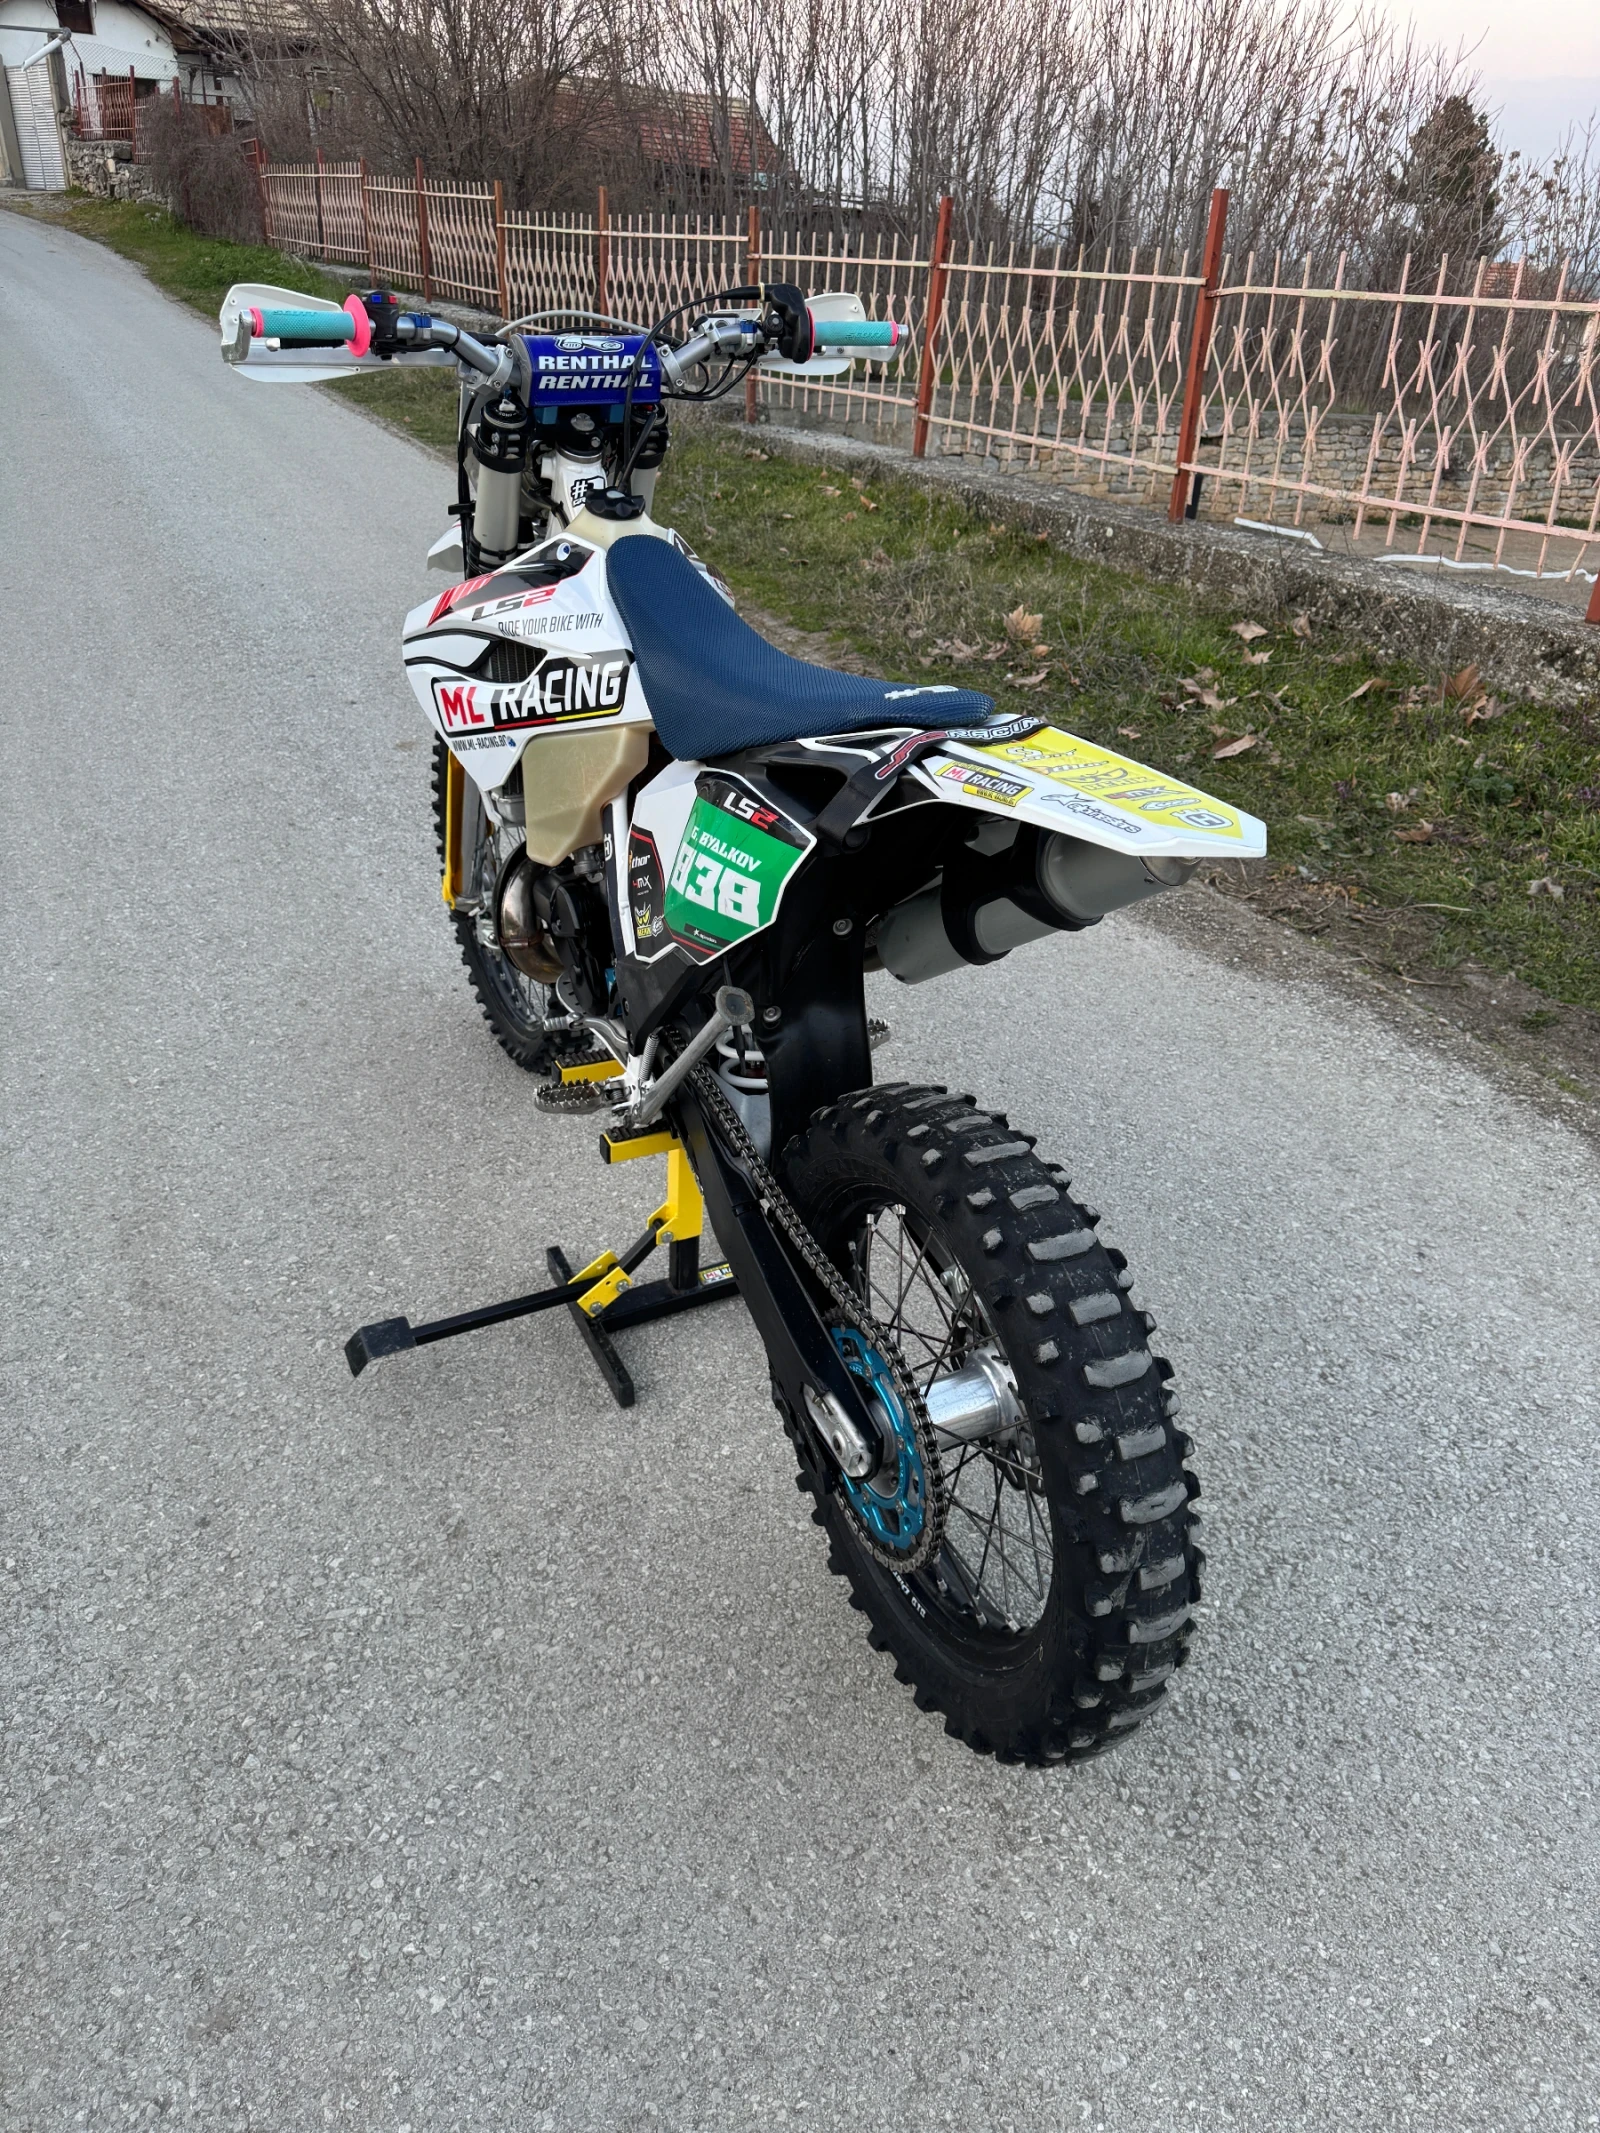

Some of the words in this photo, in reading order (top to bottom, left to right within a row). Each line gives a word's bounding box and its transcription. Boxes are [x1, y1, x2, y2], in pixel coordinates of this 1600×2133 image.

[538, 355, 653, 370] RENTHAL
[538, 373, 653, 390] RENTHAL
[471, 588, 557, 621] LS2
[498, 620, 522, 637] RIDE
[521, 617, 547, 636] YOUR
[548, 614, 575, 633] BIKE
[574, 613, 604, 630] WITH
[440, 686, 485, 727] ML
[500, 660, 624, 720] RACING
[946, 767, 967, 780] ML
[968, 773, 1023, 796] RACING
[723, 791, 780, 830] LS2
[690, 825, 699, 842] G.
[698, 831, 763, 873] BYALKOV
[670, 841, 762, 928] 838
